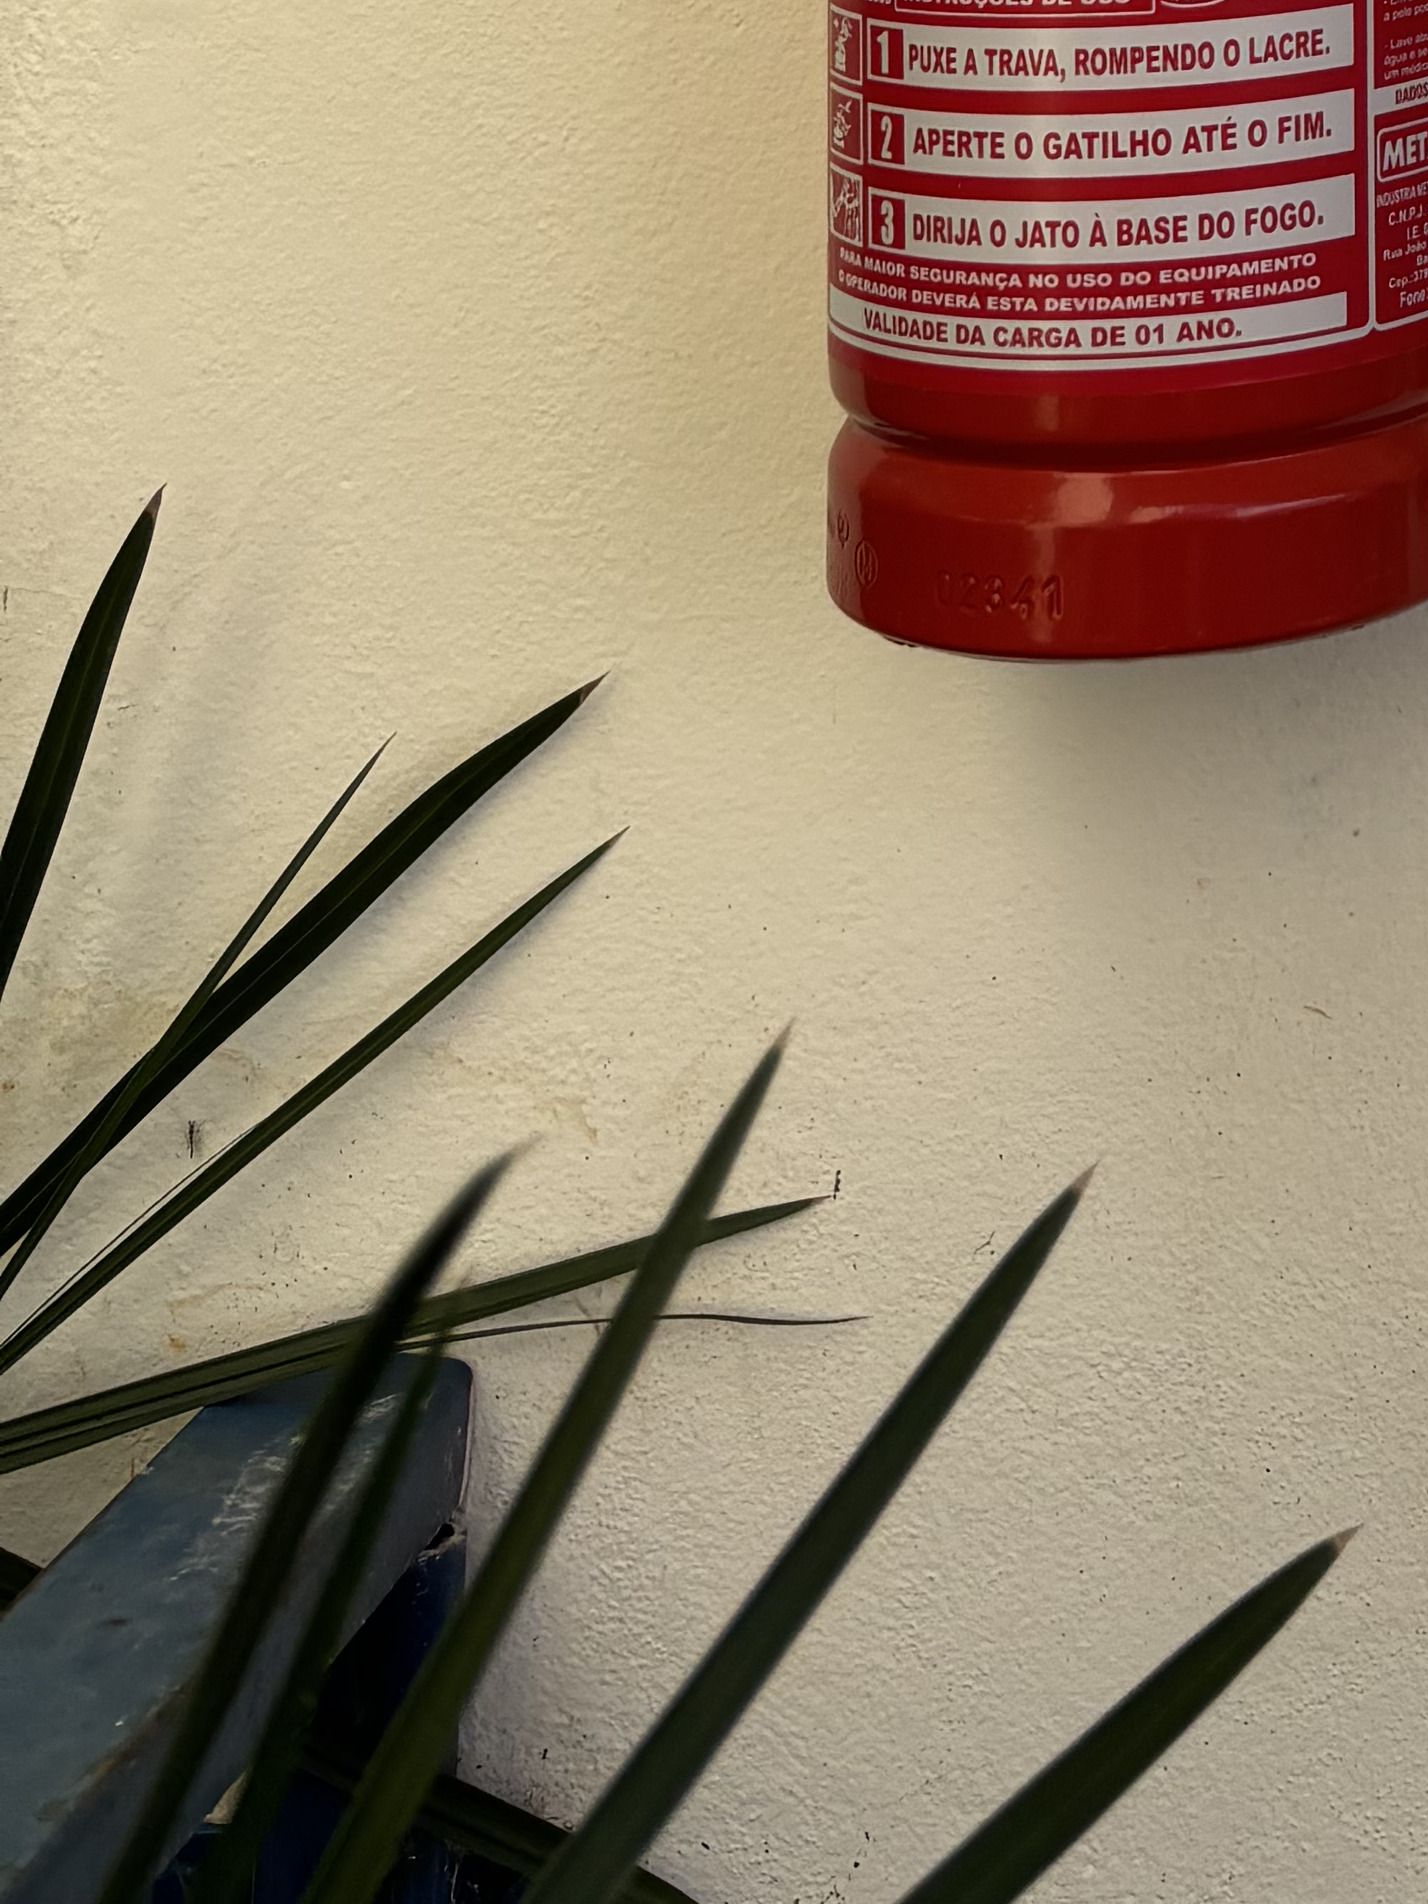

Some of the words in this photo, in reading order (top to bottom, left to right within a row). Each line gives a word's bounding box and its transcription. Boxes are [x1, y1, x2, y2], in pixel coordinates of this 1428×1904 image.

[876, 30, 889, 74] 1
[909, 43, 957, 75] PUXE
[964, 49, 978, 76] A
[984, 48, 1066, 83] TRAVA,
[1075, 40, 1215, 77] ROMPENDO
[1223, 38, 1241, 67] O
[1249, 28, 1330, 65] LACRE.
[1395, 82, 1428, 105] DADOS
[880, 115, 892, 159] 2
[913, 127, 1005, 159] APERTE
[1014, 132, 1033, 160] O
[1043, 127, 1172, 160] GATILHO
[1182, 116, 1237, 154] ATÉ
[1248, 119, 1267, 148] O
[1278, 111, 1332, 144] FIM.
[880, 200, 894, 245] 3
[913, 213, 982, 246] DIRIJA
[990, 219, 1006, 248] O
[1015, 219, 1079, 249] JATO
[1089, 212, 1107, 248] À
[1116, 214, 1188, 247] BASE
[1198, 210, 1235, 241] DO
[1245, 200, 1324, 236] FOGO.
[840, 247, 861, 266] PARA
[864, 257, 905, 278] MAIOR
[910, 265, 1022, 291] SEGURANÇA
[1028, 273, 1058, 288] NO
[1067, 272, 1113, 288] USO
[1120, 271, 1151, 286] DO
[1159, 252, 1316, 284] EQUIPAMENTO
[846, 272, 907, 300] OPERADOR
[912, 290, 984, 309] DEVERÁ
[987, 295, 1038, 311] ESTA
[1045, 290, 1204, 312] DEVIDAMENTE
[1212, 275, 1321, 301] TREINADO
[864, 306, 948, 343] VALIDADE
[955, 323, 985, 346] DA
[993, 325, 1082, 348] CARGA
[1091, 325, 1125, 347] DE
[1135, 323, 1165, 346] 01
[1176, 316, 1242, 343] ANO.
